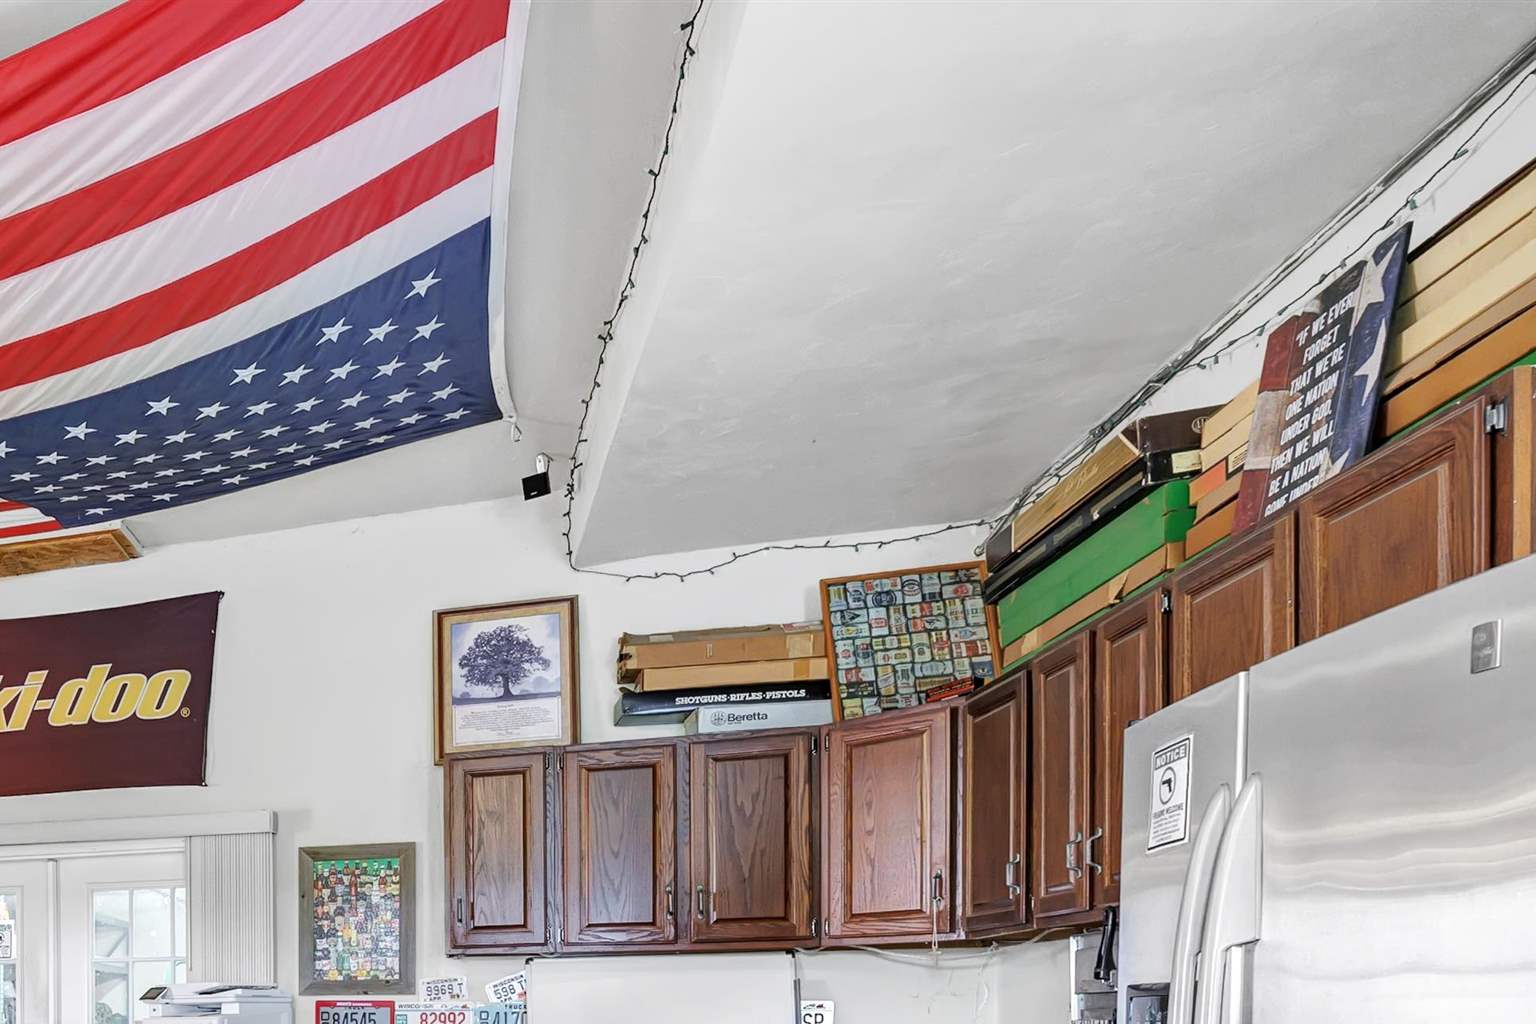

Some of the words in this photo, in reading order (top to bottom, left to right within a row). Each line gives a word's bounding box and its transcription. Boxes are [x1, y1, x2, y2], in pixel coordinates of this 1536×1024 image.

[1311, 312, 1328, 337] WE
[1302, 324, 1340, 366] FORGET
[1289, 366, 1314, 396] THAT
[1314, 342, 1346, 378] WE'RE
[1285, 395, 1305, 421] ONE
[1304, 369, 1340, 408] NATION
[1280, 413, 1312, 446] UNDER
[1270, 446, 1294, 475] THEN
[1294, 434, 1312, 458] WE
[1311, 420, 1335, 447] WILL
[1268, 475, 1283, 497] BE
[1281, 470, 1291, 489] A
[1290, 446, 1329, 483] NATION
[727, 712, 768, 722] Beretta
[1156, 744, 1187, 768] NOTICE
[426, 983, 454, 997] 9969
[494, 984, 516, 1000] 598
